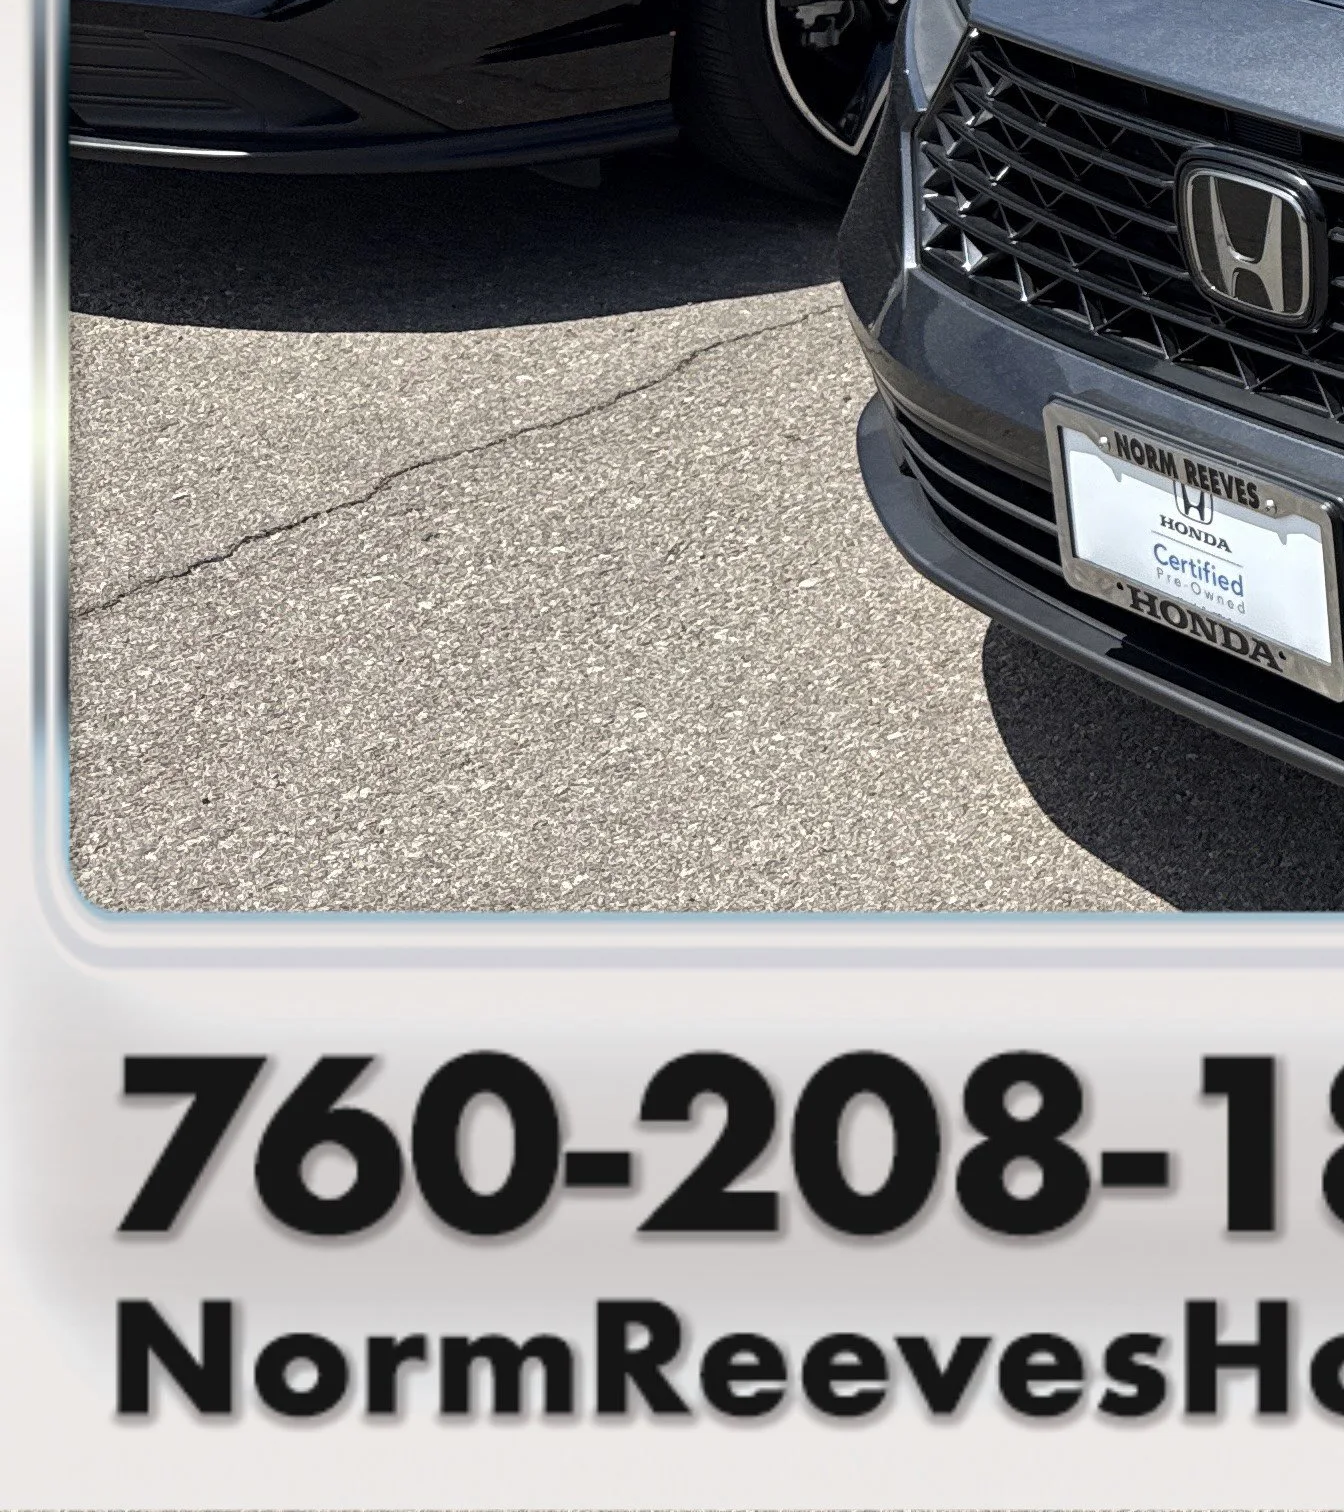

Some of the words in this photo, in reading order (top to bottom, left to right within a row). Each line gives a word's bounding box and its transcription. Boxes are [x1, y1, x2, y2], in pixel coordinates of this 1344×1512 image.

[1113, 430, 1180, 481] NORM
[1183, 458, 1261, 510] REEVES
[1159, 514, 1233, 554] HONDA
[1152, 543, 1244, 598] Certified
[1156, 567, 1246, 615] Pre-Owned
[1126, 583, 1284, 673] HONDA
